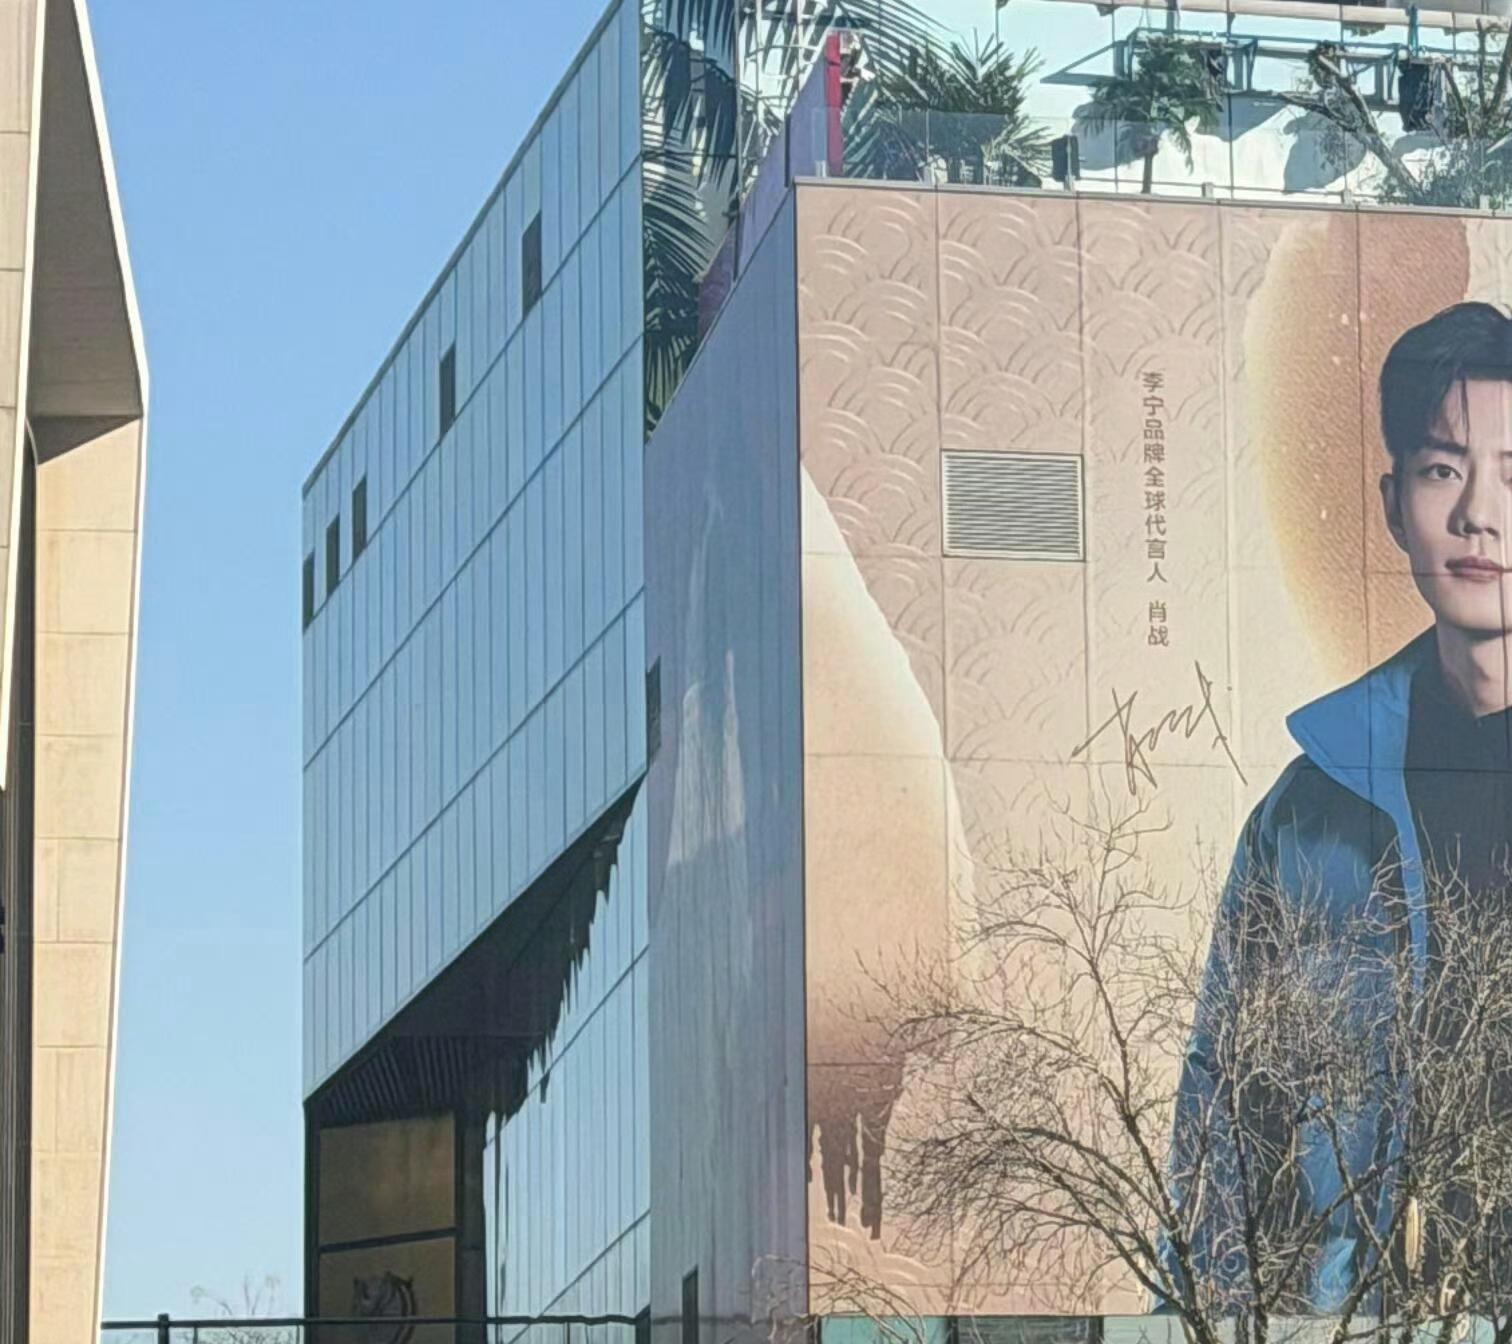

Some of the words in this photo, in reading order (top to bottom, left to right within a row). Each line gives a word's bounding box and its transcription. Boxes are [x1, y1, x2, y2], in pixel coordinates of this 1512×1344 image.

[1142, 371, 1168, 583] 李宁品牌全球代言人
[1148, 601, 1169, 647] 肖战
